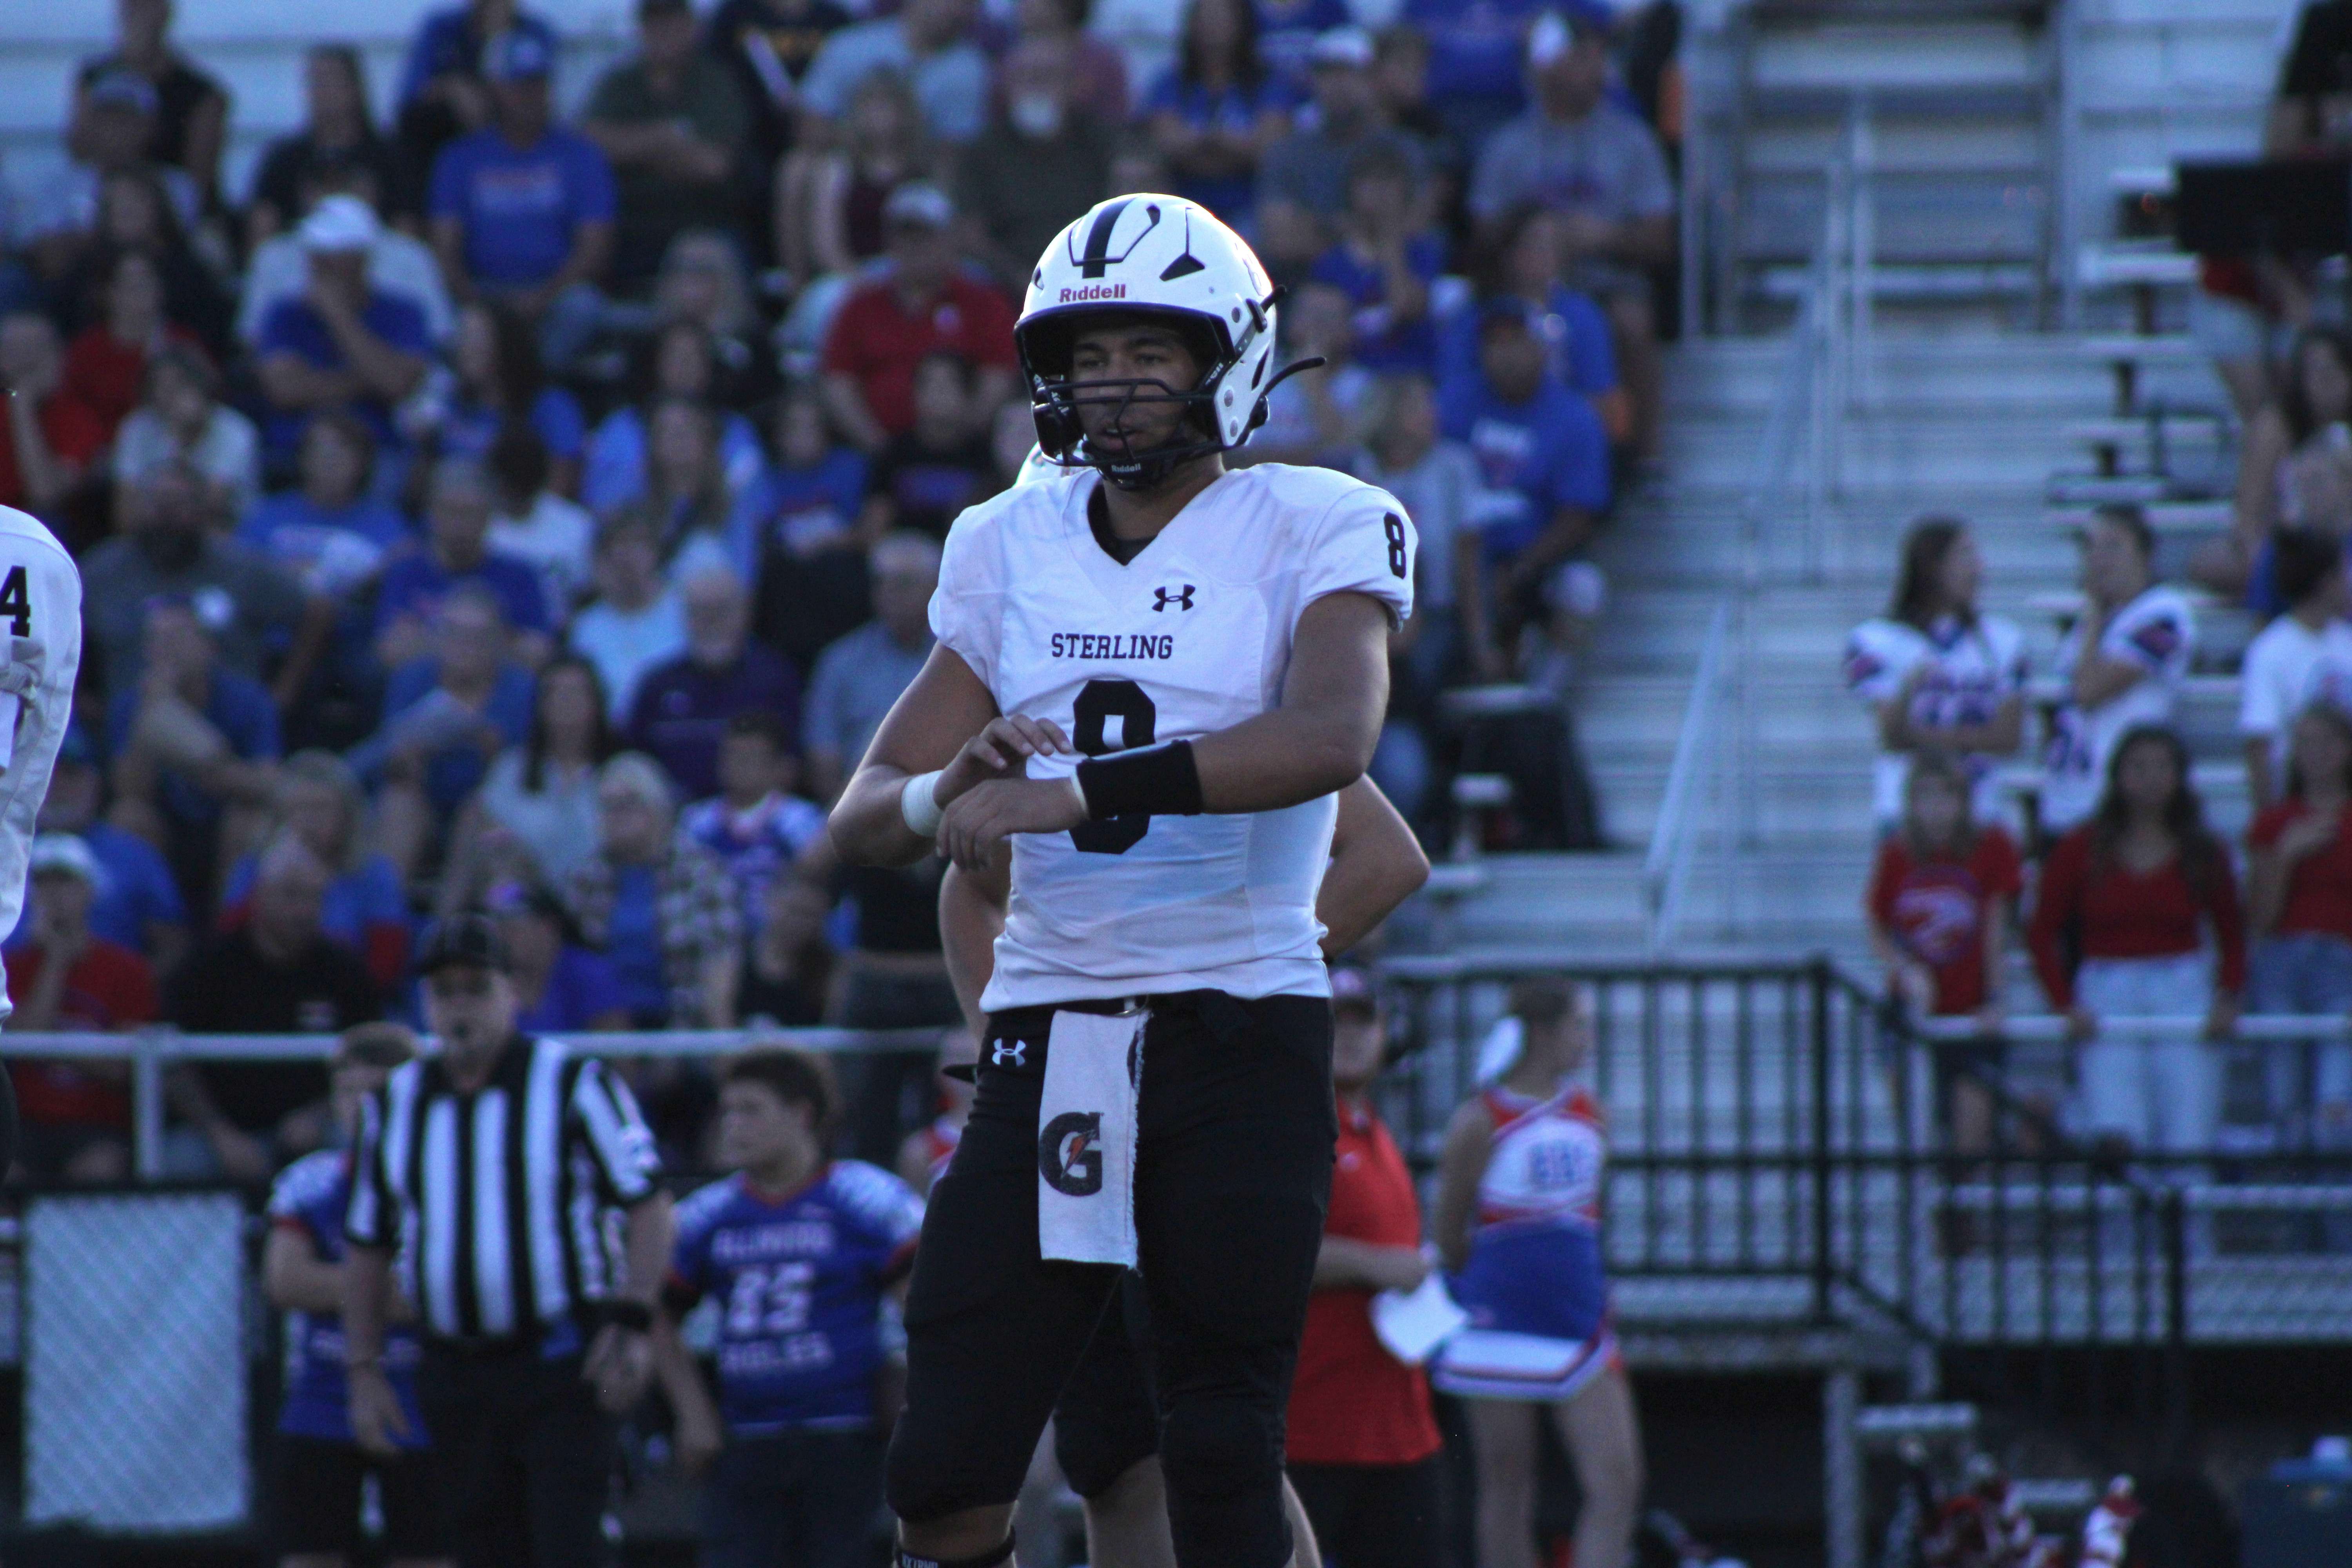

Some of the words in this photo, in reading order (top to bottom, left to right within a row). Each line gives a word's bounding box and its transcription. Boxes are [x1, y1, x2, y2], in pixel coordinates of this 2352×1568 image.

[1059, 283, 1126, 303] Riddell
[1111, 463, 1141, 472] Riddell
[1383, 510, 1407, 580] 8
[0, 564, 30, 638] 4
[1051, 632, 1173, 659] STERLING
[1038, 1111, 1103, 1197] G
